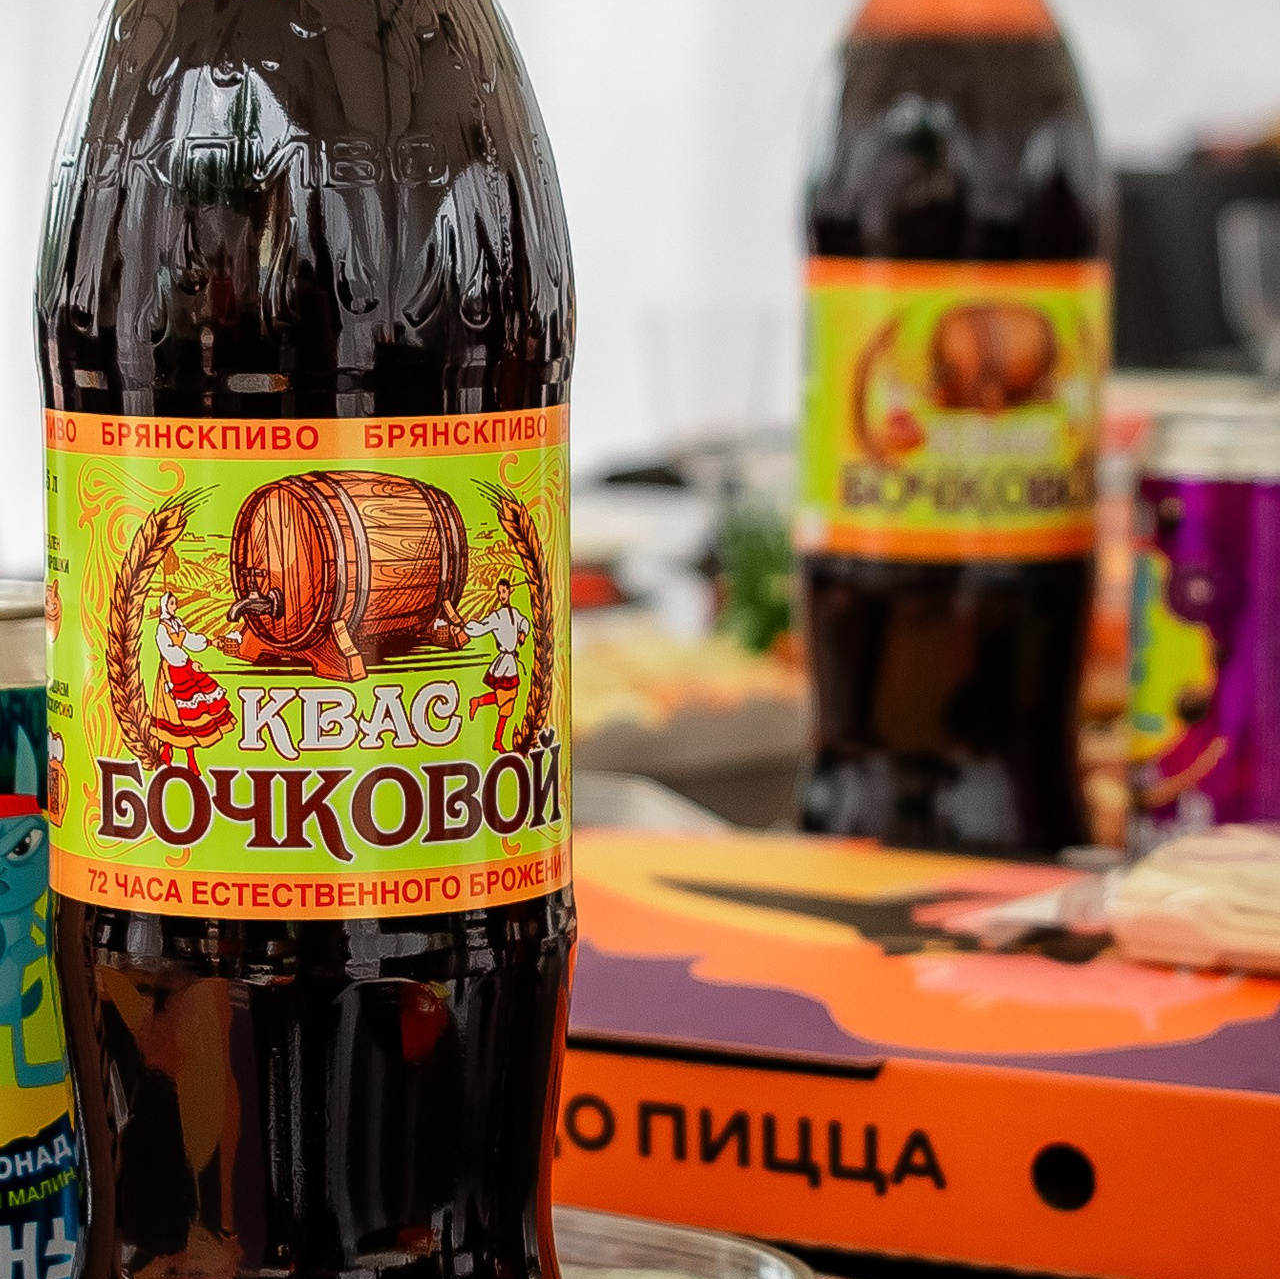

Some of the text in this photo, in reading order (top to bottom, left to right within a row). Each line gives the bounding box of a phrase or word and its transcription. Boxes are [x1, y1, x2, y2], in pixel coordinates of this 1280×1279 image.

[102, 422, 319, 450] БРЯНСКПИВО
[364, 414, 548, 449] БРЯНСКПИВО
[237, 679, 461, 759] КВАС
[97, 727, 564, 863] БОЧКОВОЙ
[87, 850, 569, 908] 72 ЧАСА ЕСТЕСТВЕННОГО БРОЖЕНИЯ
[637, 1100, 948, 1197] ПИЦЦА
[7, 1165, 77, 1208] МАЛИН
